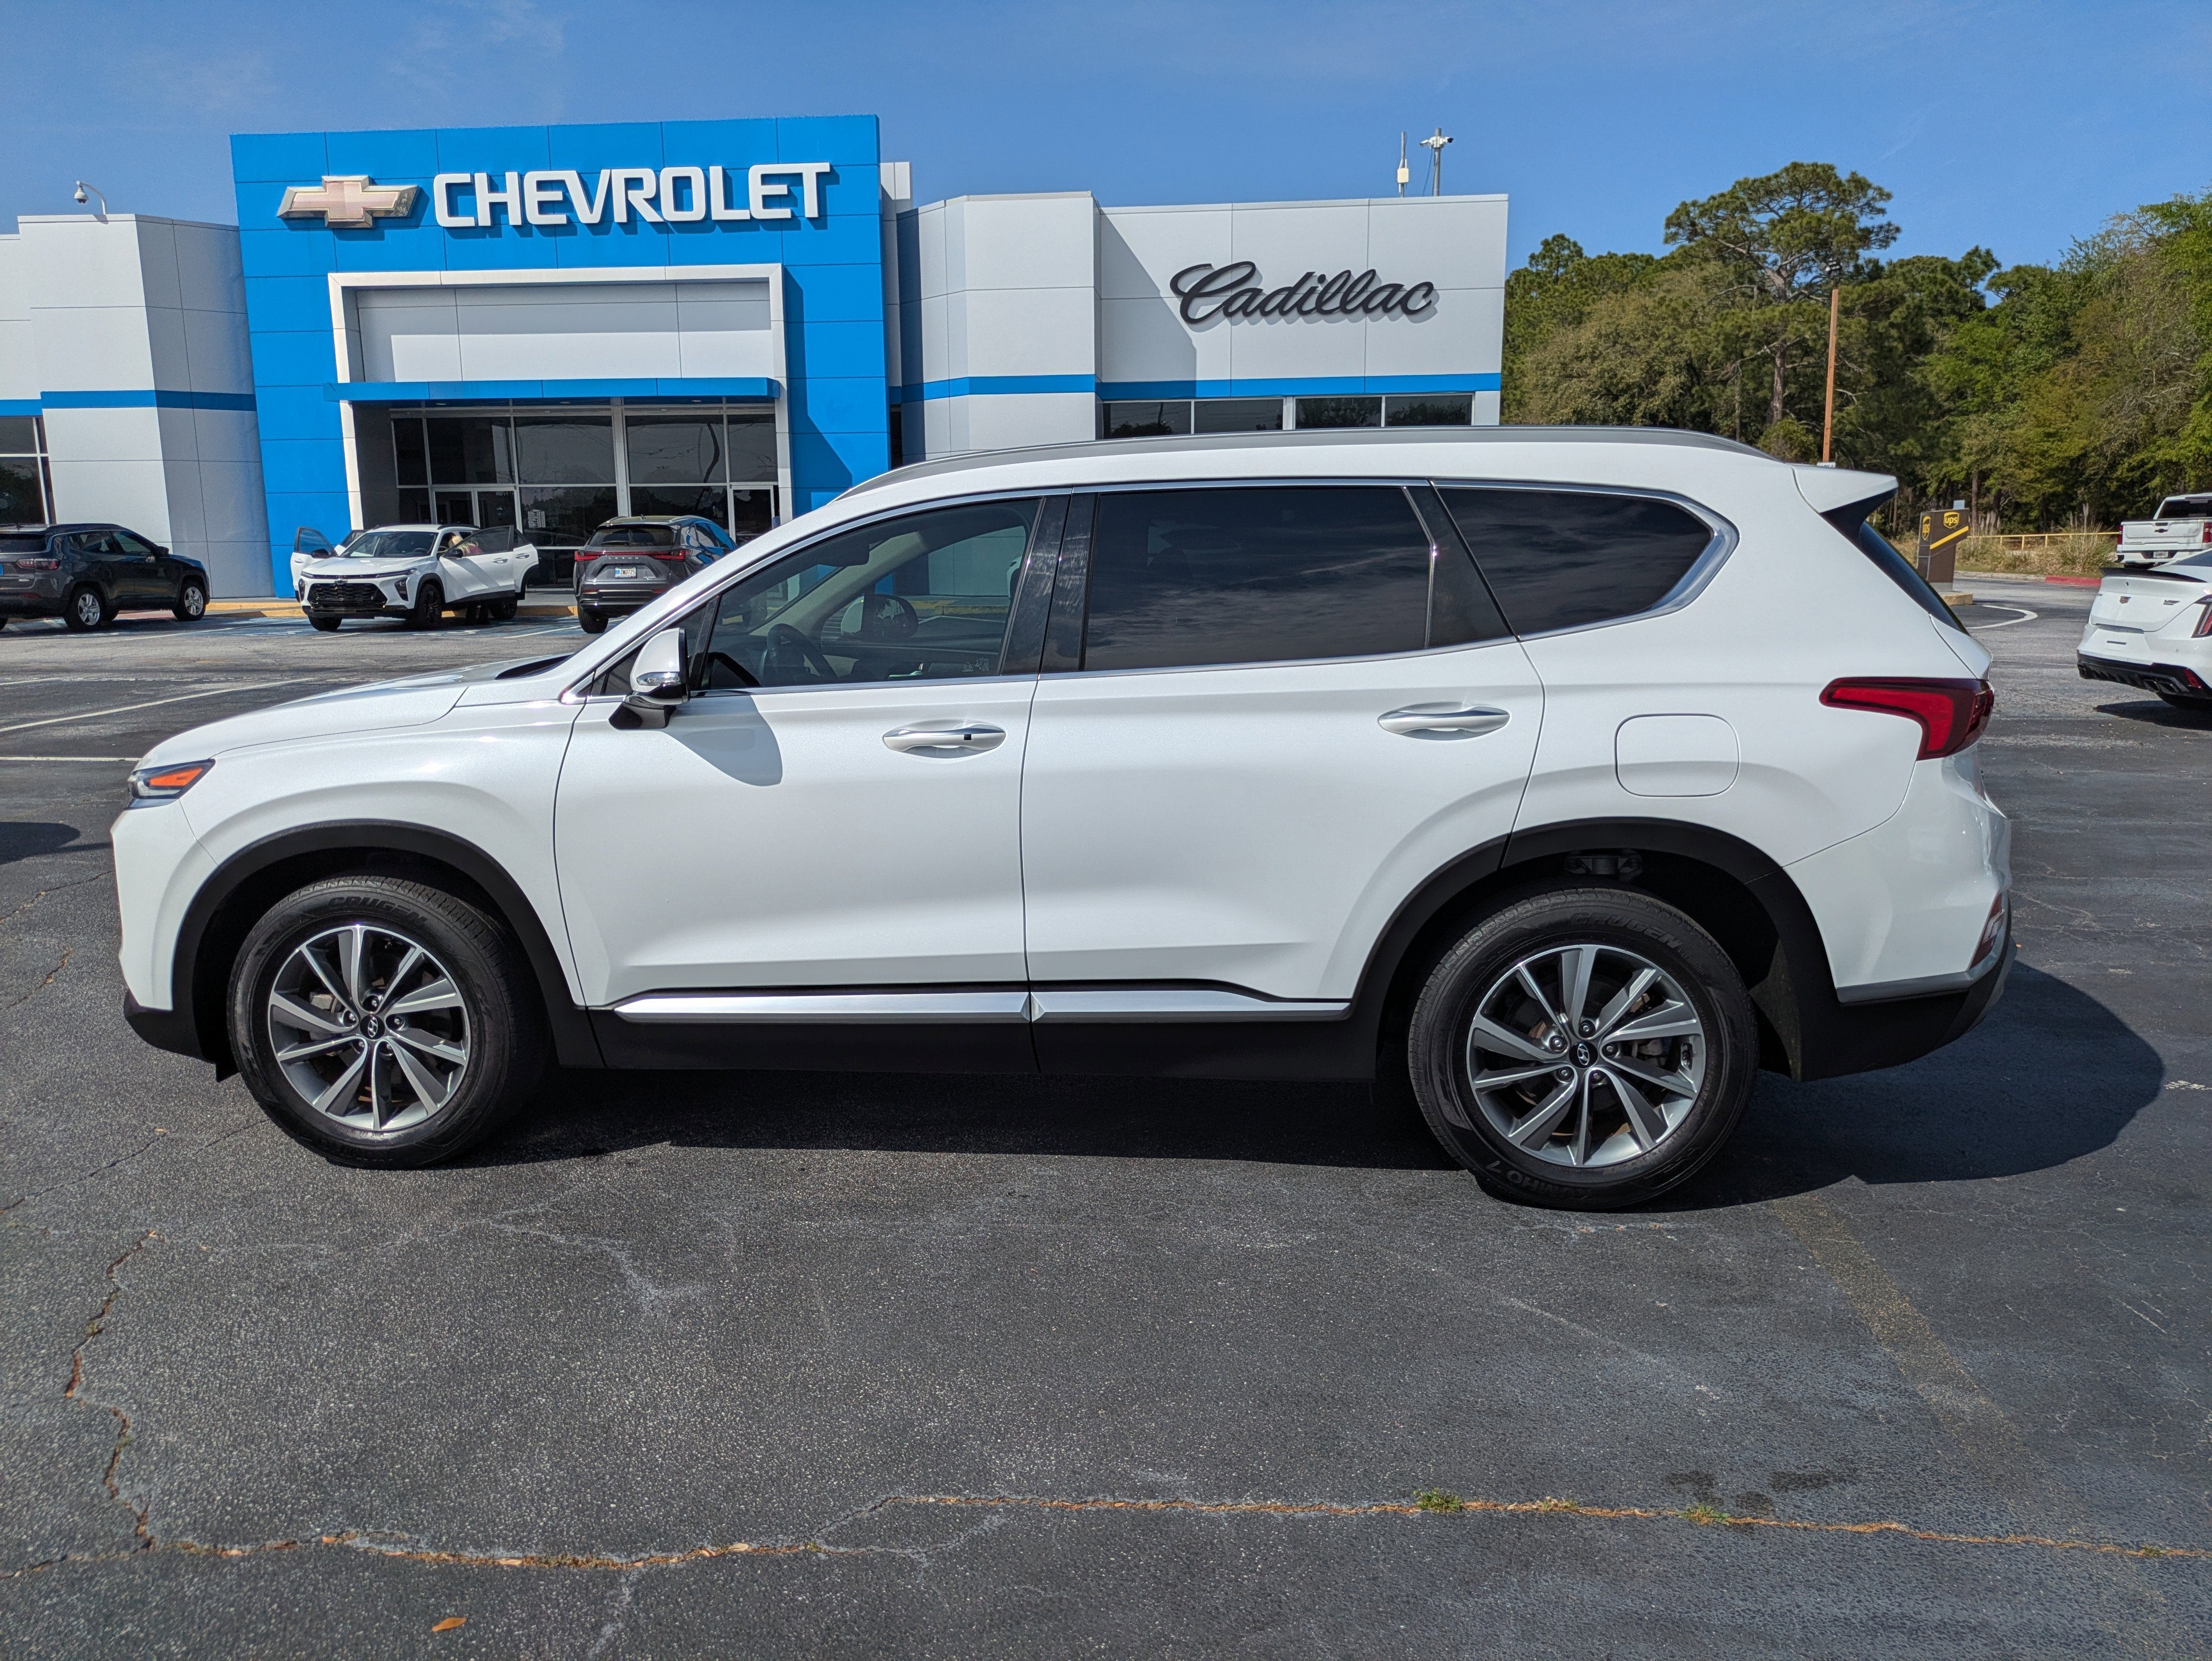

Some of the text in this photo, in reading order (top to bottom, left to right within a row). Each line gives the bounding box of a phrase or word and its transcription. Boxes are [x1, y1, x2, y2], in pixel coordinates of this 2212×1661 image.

[433, 163, 830, 227] CHEVROLET
[1170, 261, 1434, 324] Cadillac
[1945, 517, 1958, 526] ups
[1570, 912, 1683, 948] CRUGEN
